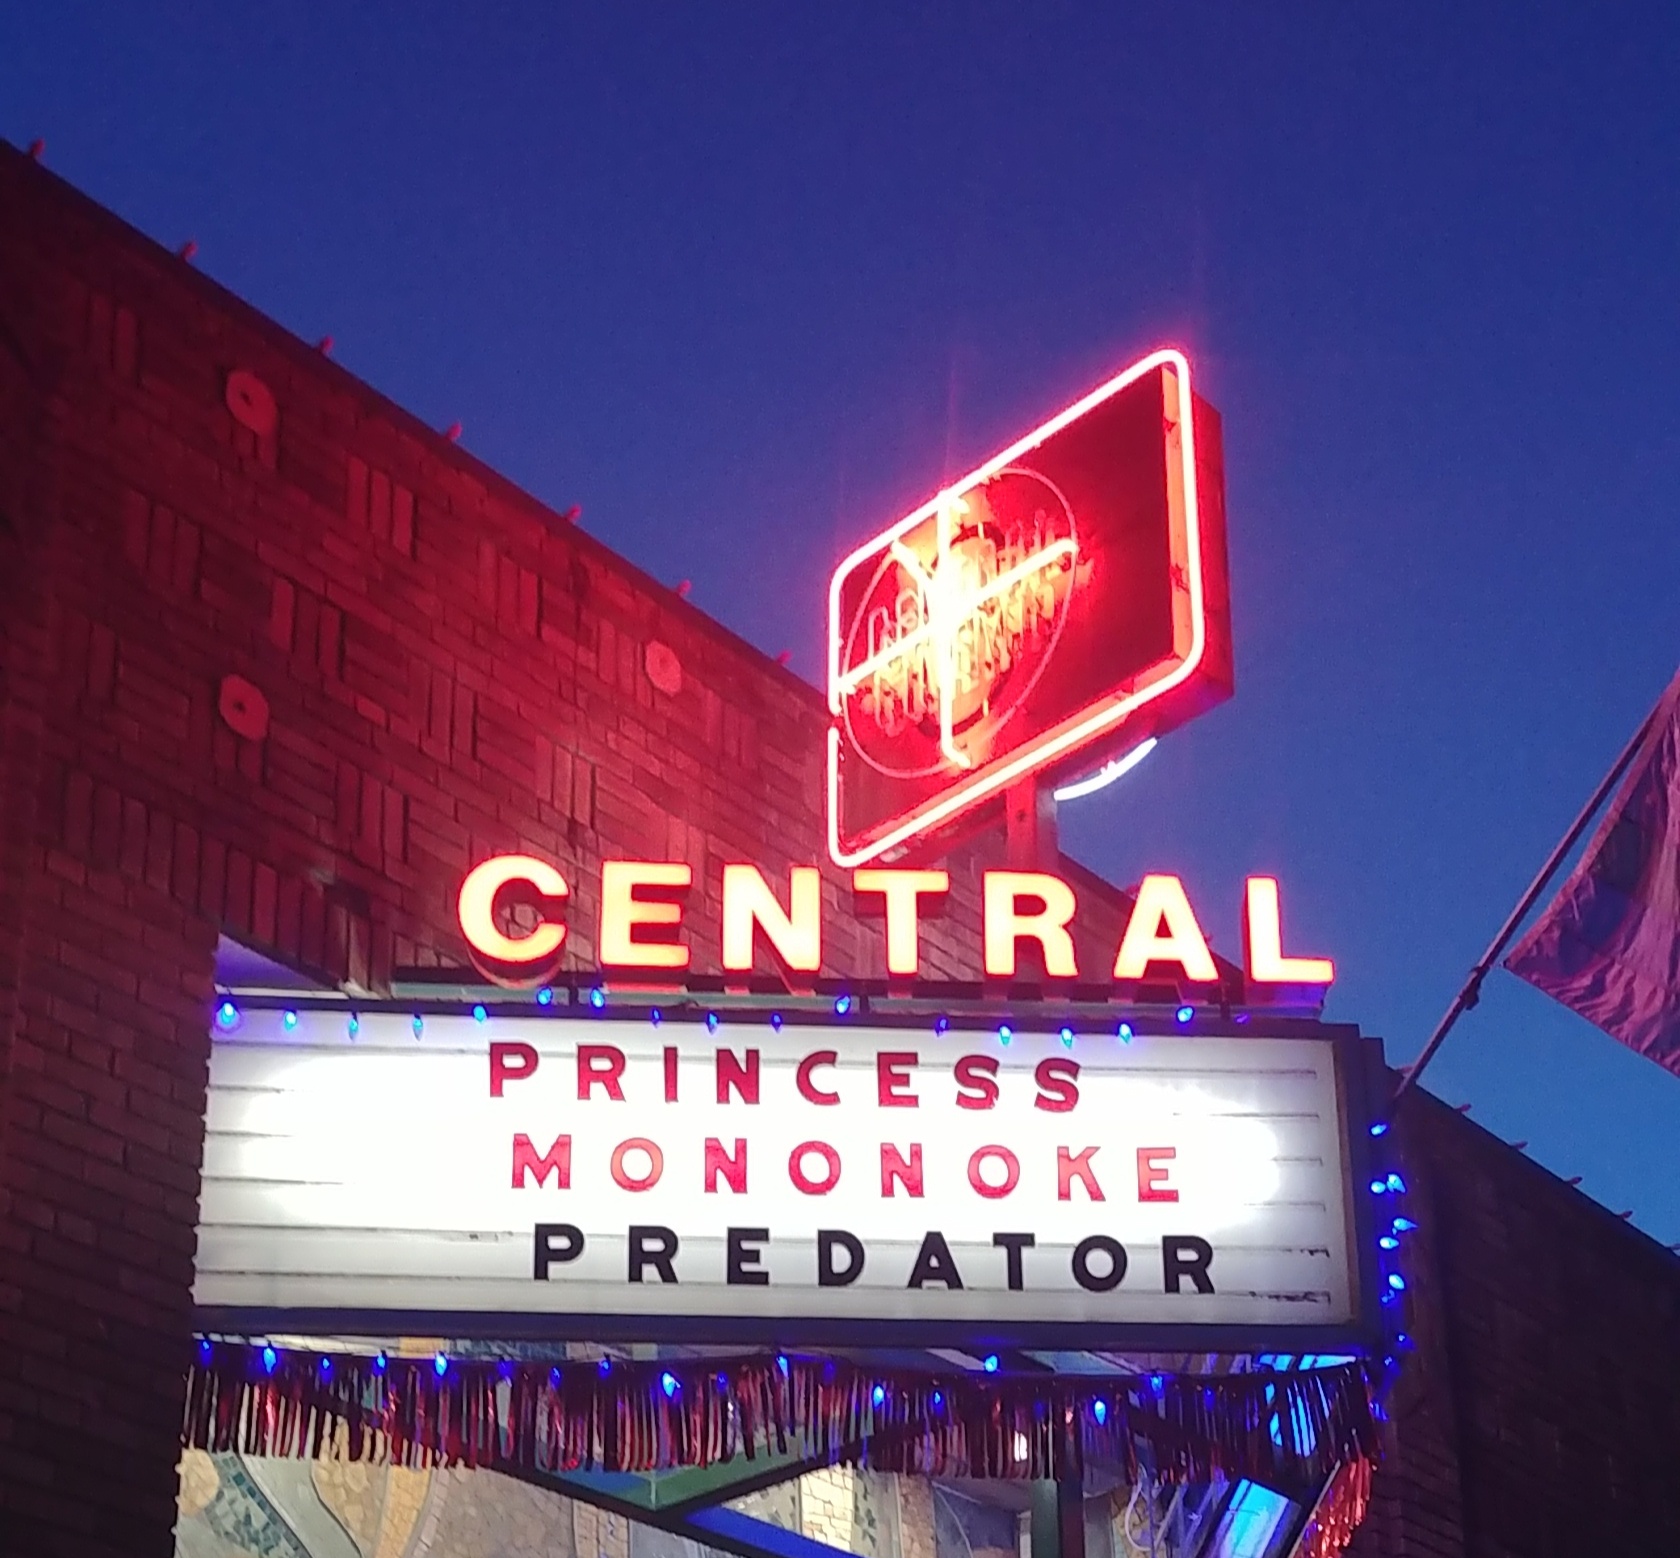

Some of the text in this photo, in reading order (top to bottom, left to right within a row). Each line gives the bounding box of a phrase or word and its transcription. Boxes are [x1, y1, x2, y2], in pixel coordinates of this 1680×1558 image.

[459, 854, 1336, 986] CENTRAL
[488, 1040, 1081, 1114] PRINCESS
[511, 1131, 1180, 1203] MONONOKE
[531, 1223, 1215, 1295] PREDATOR
